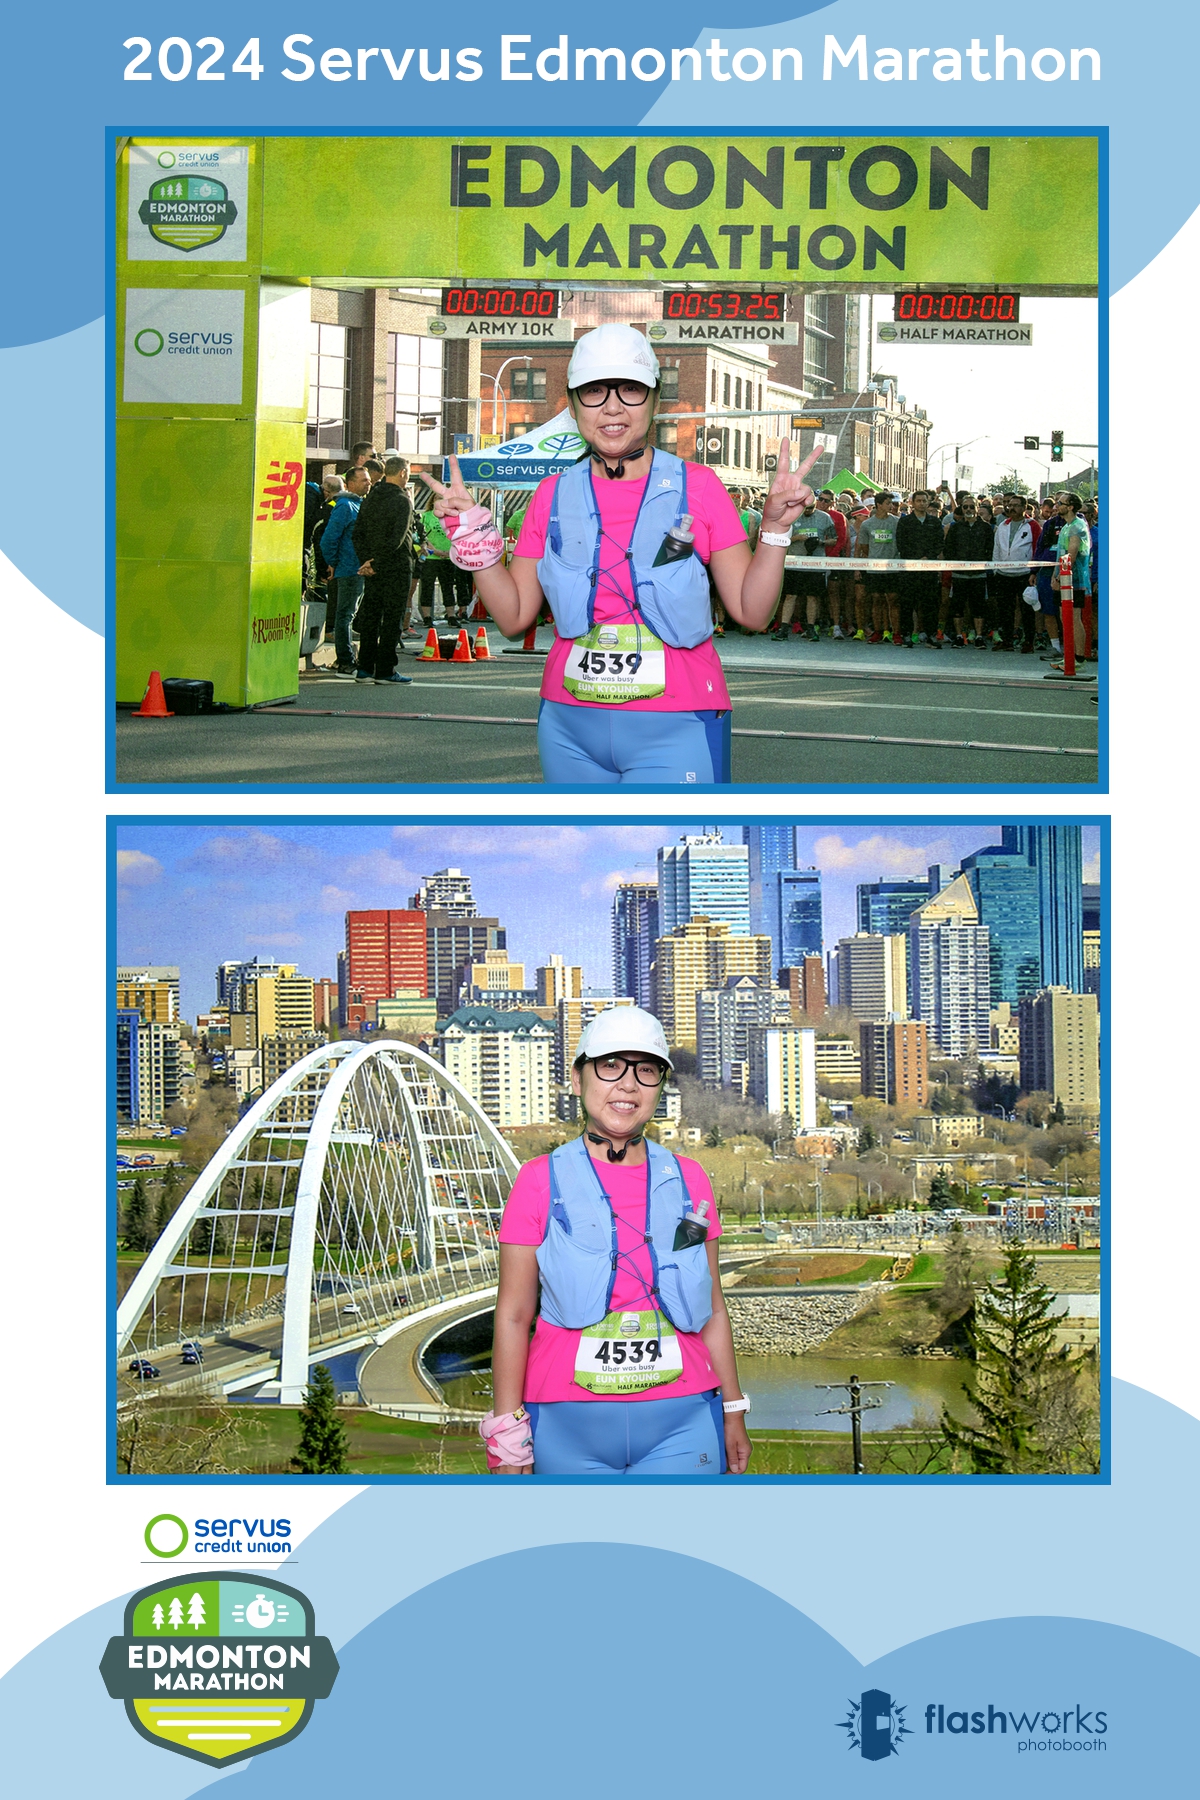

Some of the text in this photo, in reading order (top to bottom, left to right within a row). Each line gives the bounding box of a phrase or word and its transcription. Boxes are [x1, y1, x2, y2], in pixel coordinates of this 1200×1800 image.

[178, 152, 220, 161] servus
[450, 144, 991, 211] EDMONTON
[149, 203, 227, 214] EDMONTON
[160, 214, 216, 222] MARATHON
[523, 223, 907, 272] MARATHON
[466, 321, 554, 336] ARMY 10K
[678, 325, 785, 340] MARATHON
[900, 327, 1031, 341] HALF MARATHON
[168, 332, 233, 345] servus
[167, 345, 233, 355] credit union
[496, 464, 546, 475] servus
[578, 651, 642, 675] 4539
[582, 674, 598, 682] Uber
[617, 675, 635, 684] busy
[578, 684, 595, 693] EUN
[597, 684, 640, 694] KYOUNG
[595, 1340, 660, 1364] 4539
[601, 1364, 620, 1373] Uber
[638, 1363, 656, 1372] busy
[595, 1372, 661, 1384] EUN KYOUNG
